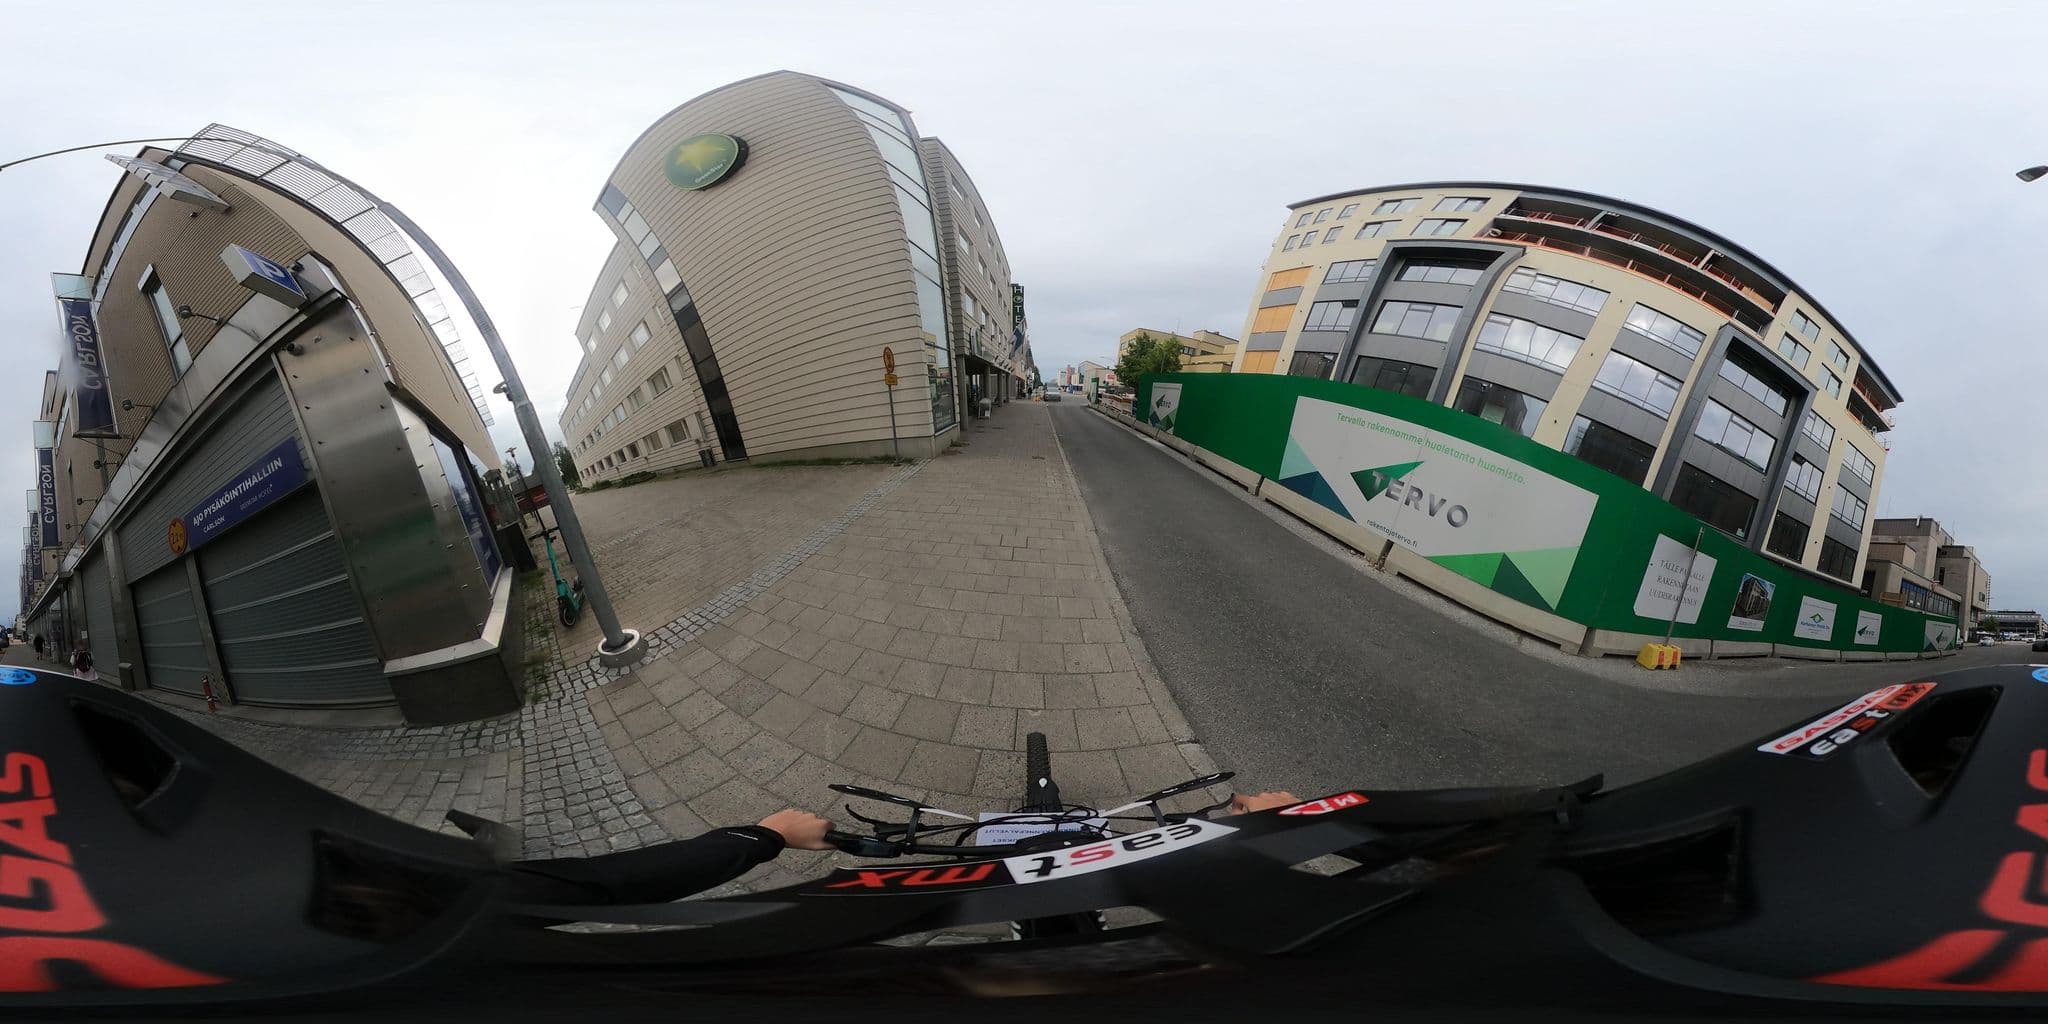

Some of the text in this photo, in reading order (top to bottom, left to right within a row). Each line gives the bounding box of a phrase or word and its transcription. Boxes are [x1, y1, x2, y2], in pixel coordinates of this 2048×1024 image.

[252, 255, 287, 279] P
[192, 514, 204, 527] AJO
[202, 457, 283, 518] PYSÄKÖINTIHALLIIN
[1371, 470, 1469, 528] TERVO
[203, 515, 226, 534] CARLSON
[1774, 686, 1897, 751] GASGAS
[1809, 709, 1891, 756] east
[825, 822, 1203, 889] east mx
